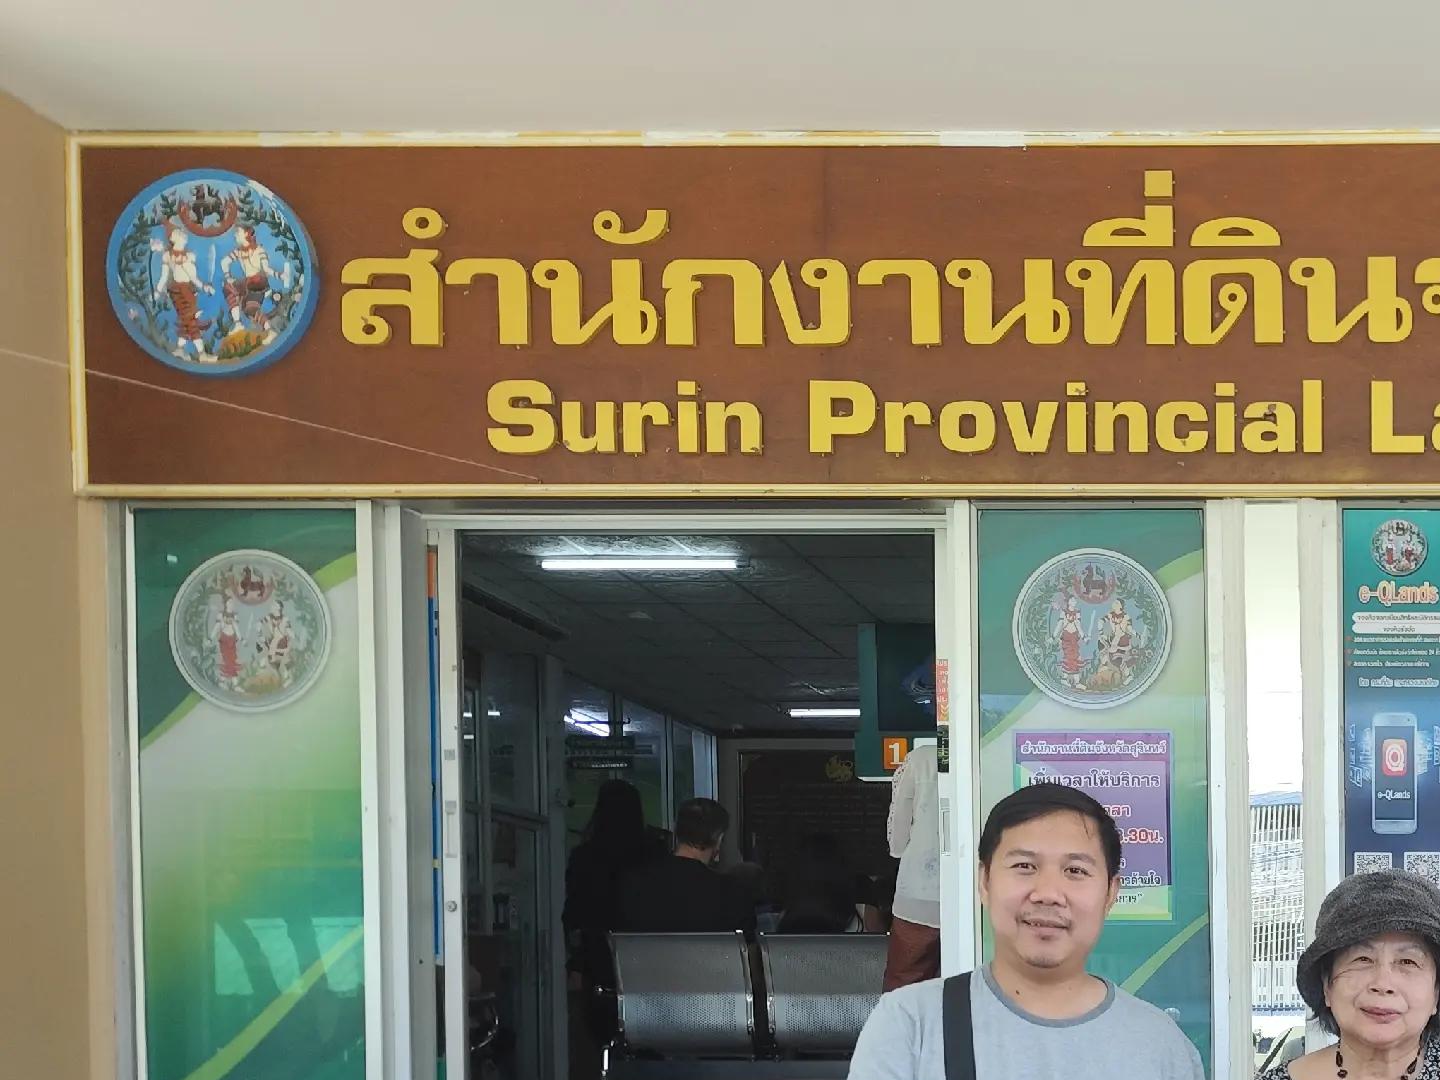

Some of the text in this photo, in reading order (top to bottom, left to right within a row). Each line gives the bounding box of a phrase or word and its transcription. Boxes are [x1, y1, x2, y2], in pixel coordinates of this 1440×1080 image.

[486, 379, 763, 454] Surin
[808, 379, 1324, 454] Provincial
[1358, 580, 1440, 607] e-QLands
[1021, 738, 1167, 758] สำนักงานที่ดินจังหวัดสุรินทร์
